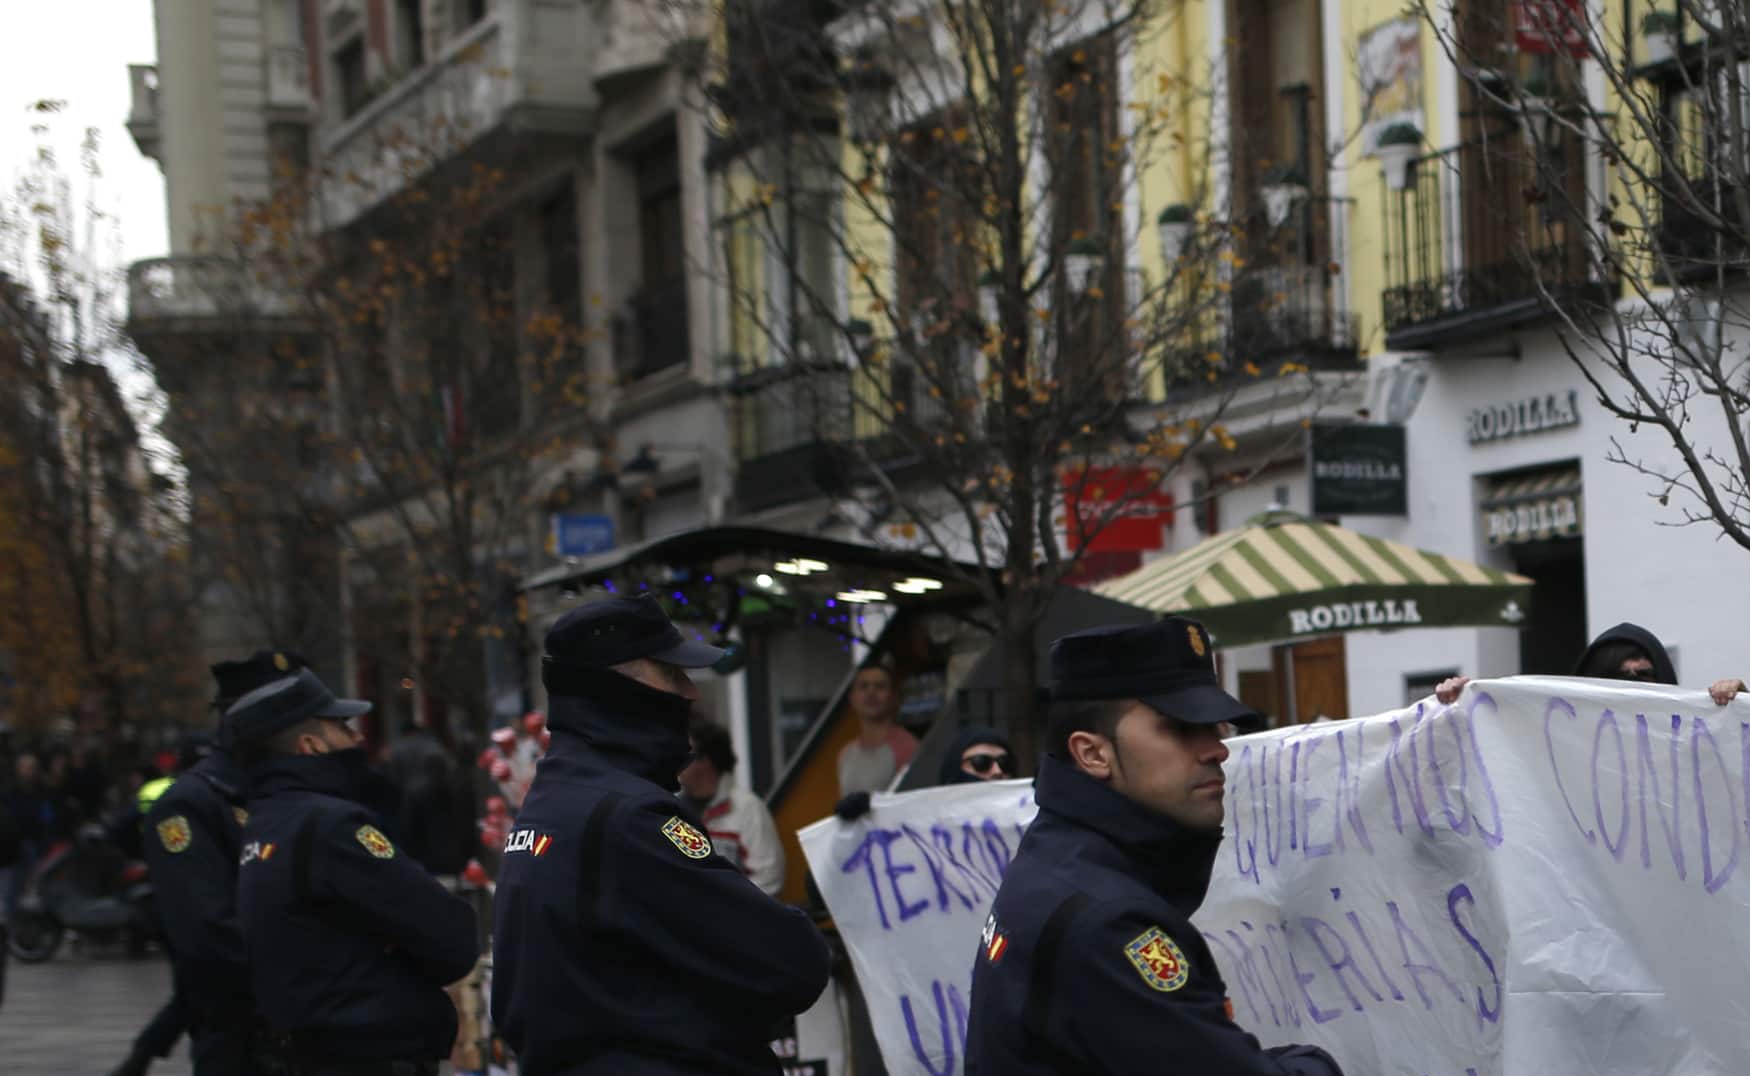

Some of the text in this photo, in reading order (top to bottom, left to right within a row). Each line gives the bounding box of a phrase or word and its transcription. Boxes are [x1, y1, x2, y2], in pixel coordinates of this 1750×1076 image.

[1466, 388, 1580, 445] RODILLA
[1315, 460, 1402, 479] RODILLA
[1289, 600, 1422, 634] RODILLA
[1231, 722, 1376, 885] QUIEN
[1386, 691, 1504, 850] NOS
